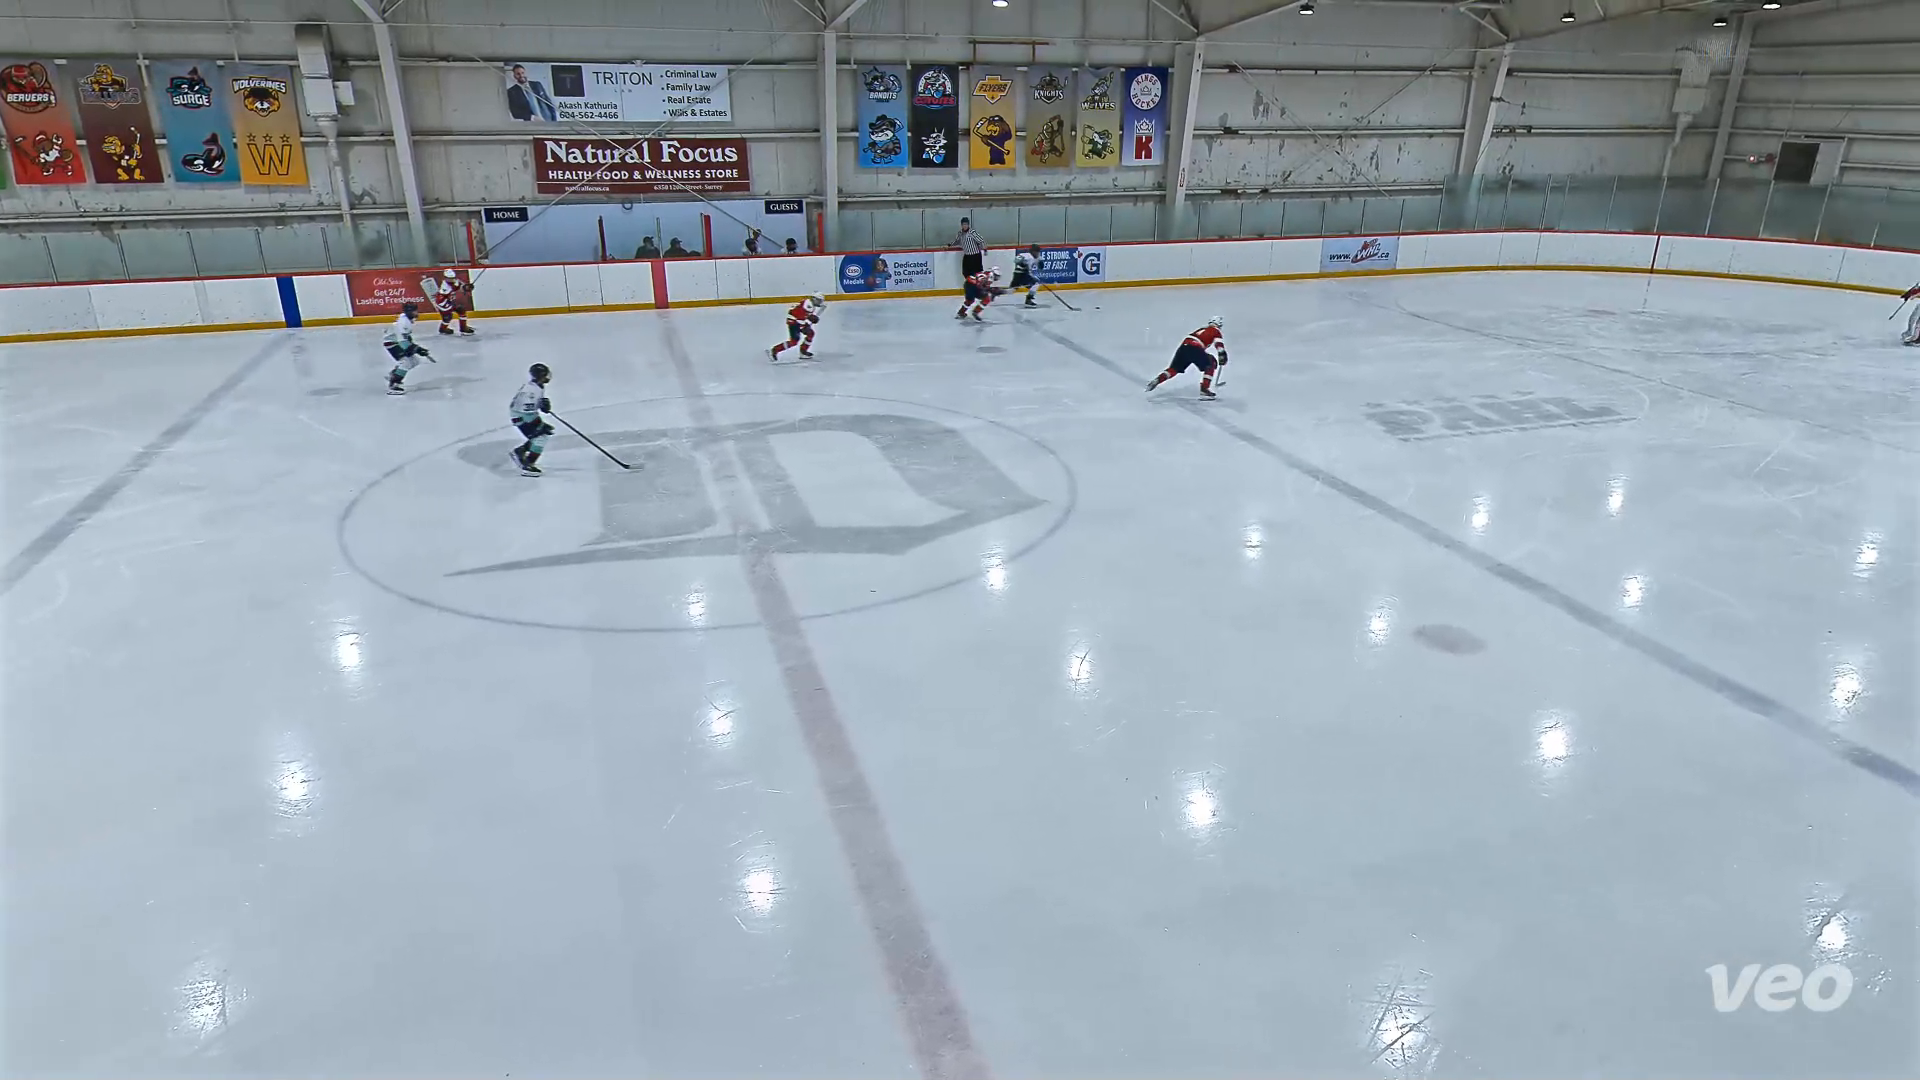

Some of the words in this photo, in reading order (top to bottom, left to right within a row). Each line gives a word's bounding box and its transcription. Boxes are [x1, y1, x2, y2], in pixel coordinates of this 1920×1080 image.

[592, 71, 653, 86] TRITON
[665, 70, 698, 78] Criminal
[701, 70, 717, 79] Law
[1135, 74, 1158, 86] KINGS
[232, 79, 286, 93] WOLVERINES
[666, 83, 692, 92] Family
[694, 84, 710, 92] Law
[978, 84, 1008, 92] FLYERS
[6, 93, 50, 102] BEAVERS
[172, 93, 211, 106] SURGE
[868, 91, 898, 100] BANDITS
[1034, 89, 1064, 100] KNIGHTS
[667, 96, 684, 104] Real
[686, 96, 712, 104] Estate
[914, 96, 955, 105] COYOTES
[1132, 92, 1160, 109] HOCKEY
[558, 102, 582, 110] Akash
[584, 102, 618, 110] Kathuria
[560, 112, 618, 120] 604-562-4466
[690, 108, 698, 117] &
[699, 109, 728, 117] Estates
[544, 140, 651, 164] Natural
[660, 140, 738, 164] Focus
[1134, 134, 1154, 160] K
[247, 142, 293, 176] W
[548, 170, 592, 180] HEALTH
[596, 170, 629, 180] FOOD
[633, 170, 642, 180] &
[644, 169, 702, 180] WELLNESS
[705, 168, 739, 178] STORE
[770, 202, 799, 212] GUESTS
[492, 210, 520, 220] HOME
[1046, 250, 1071, 260] STRONG.
[894, 261, 928, 269] Dedicated
[1052, 260, 1068, 270] FAST.
[1082, 252, 1102, 276] G
[902, 268, 932, 276] Canada's
[894, 278, 915, 286] game.
[388, 288, 406, 296] 24/7
[356, 297, 384, 306] Lasting
[385, 296, 424, 304] Freshness
